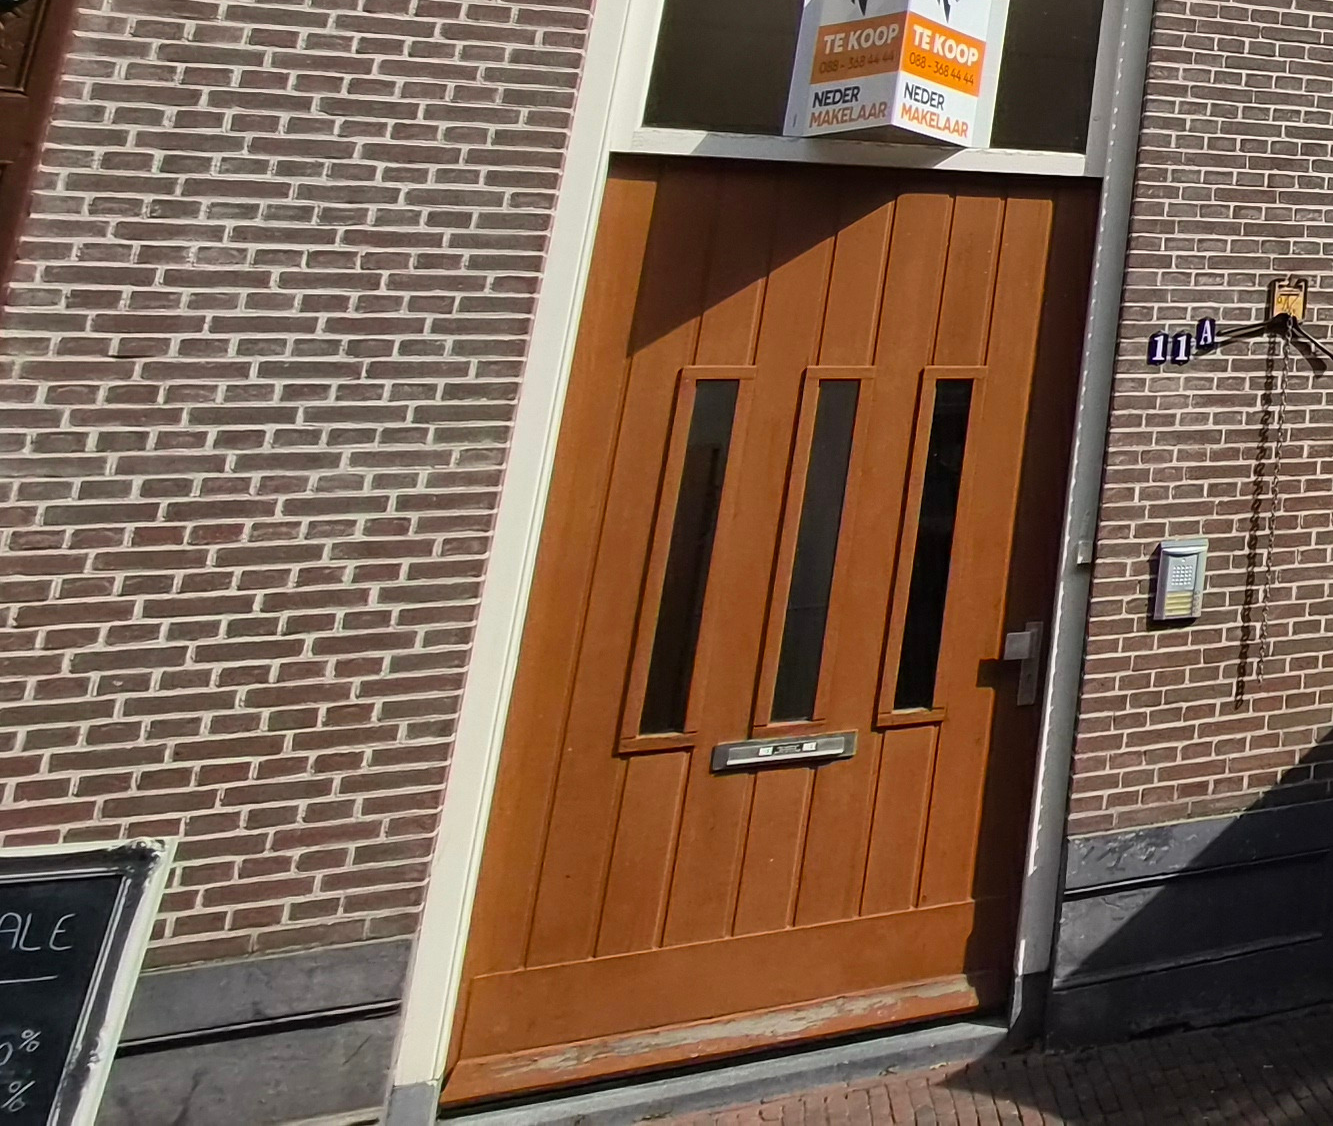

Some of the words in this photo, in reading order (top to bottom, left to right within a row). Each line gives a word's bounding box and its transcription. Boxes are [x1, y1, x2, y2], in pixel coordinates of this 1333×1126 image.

[824, 33, 845, 55] TE
[847, 23, 900, 53] KOOP
[913, 24, 932, 50] TE
[933, 35, 979, 66] KOOP
[909, 52, 927, 70] 088
[934, 60, 949, 78] 368
[950, 69, 962, 83] 44
[963, 72, 975, 85] 44
[812, 85, 861, 108] NEDER
[903, 82, 945, 110] NEDER
[809, 101, 888, 128] MAKELAAR
[901, 102, 969, 139] MAKELAAR
